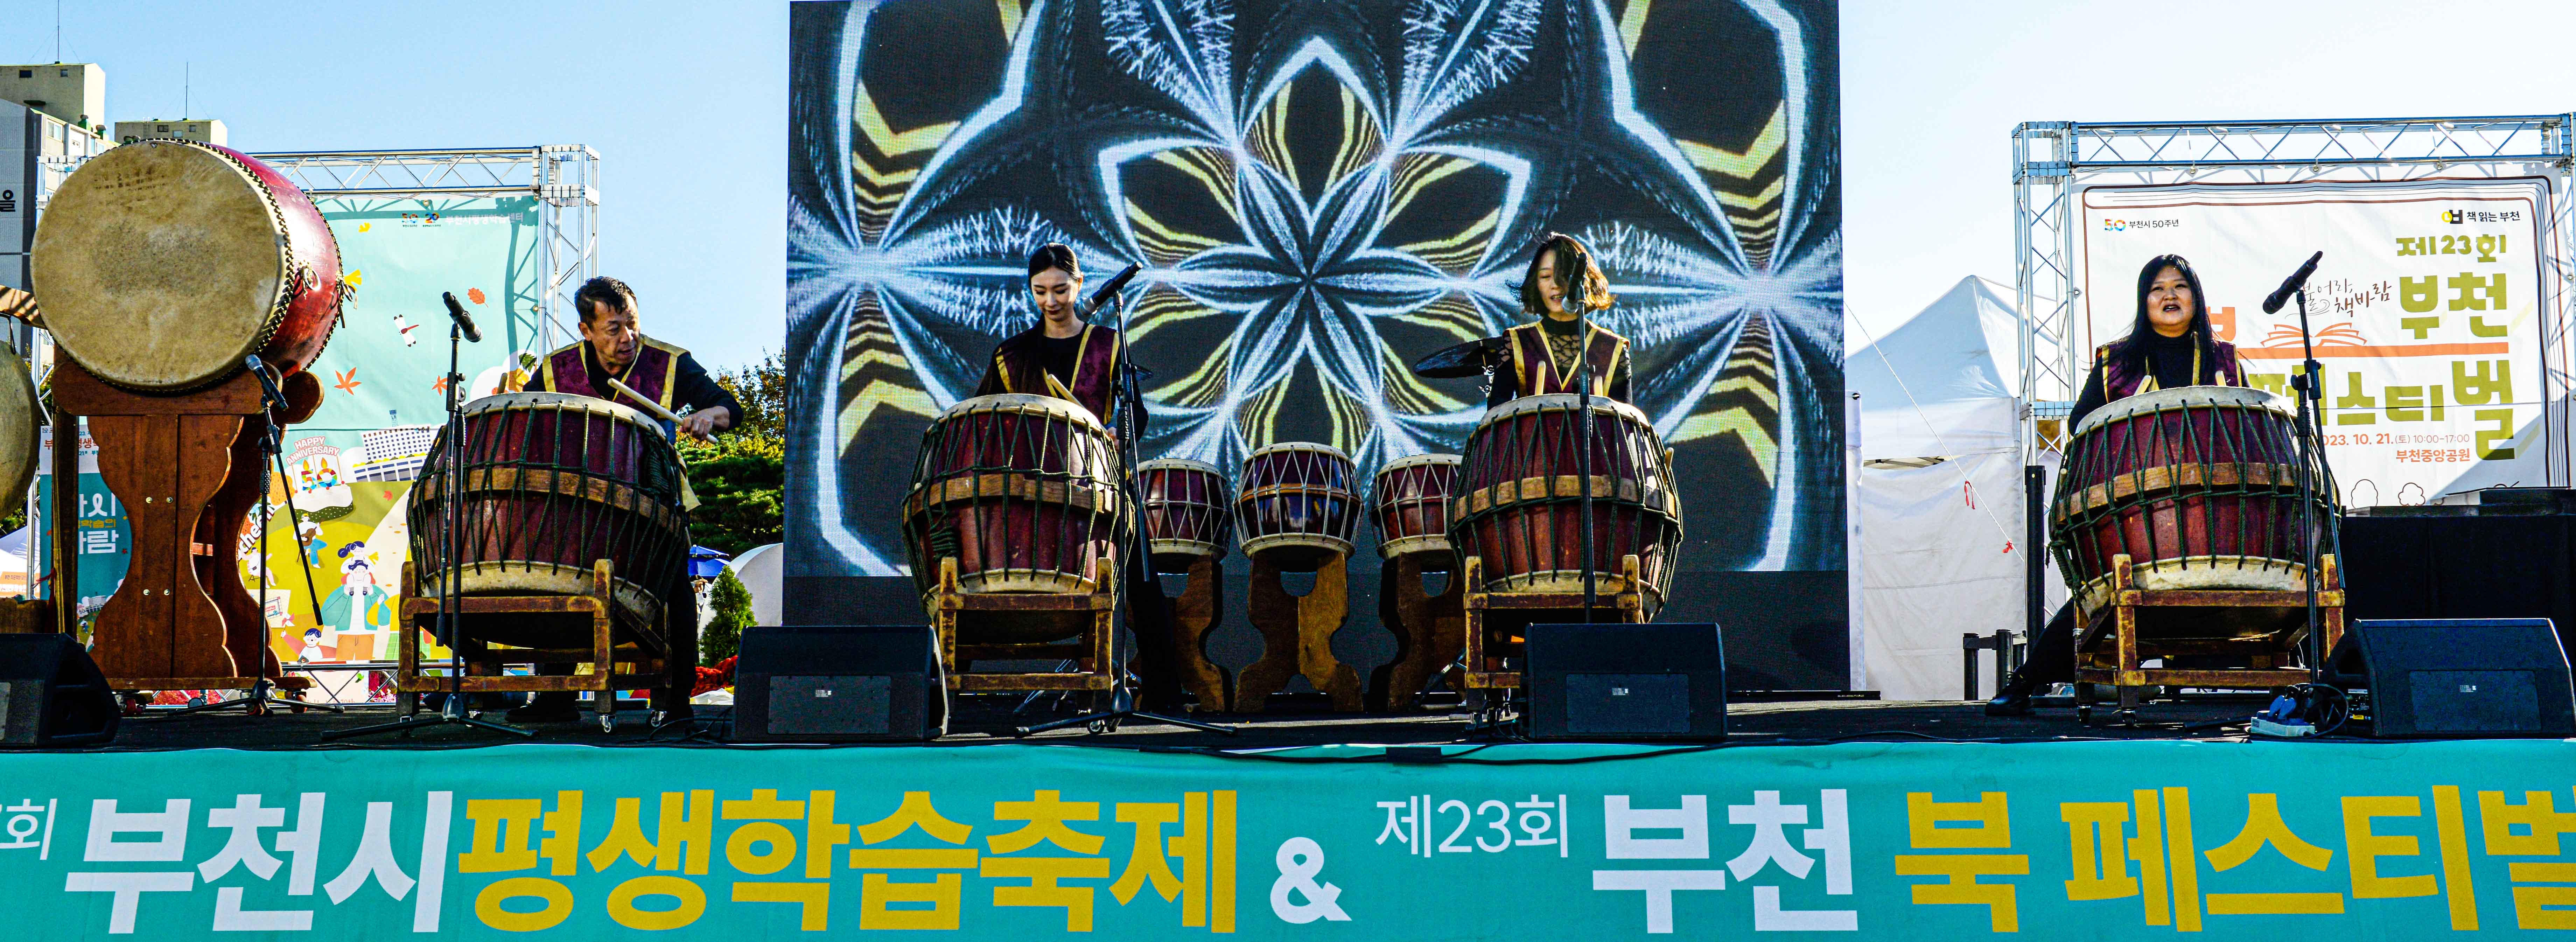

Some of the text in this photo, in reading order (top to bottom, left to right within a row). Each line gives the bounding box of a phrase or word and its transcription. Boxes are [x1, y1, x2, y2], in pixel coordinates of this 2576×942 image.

[2129, 220, 2150, 228] 부천시
[2152, 219, 2179, 228] 50주년
[2467, 211, 2520, 222] 책 읽는 부천
[2396, 234, 2506, 263] 제23회
[2334, 281, 2392, 318] 책바람
[2400, 272, 2508, 340] 부천
[294, 436, 326, 449] HAPPY
[2322, 434, 2349, 446] 023.
[2353, 434, 2372, 445] 10.
[2414, 434, 2470, 443] 10:00-17:00
[286, 445, 341, 465] ANNIVERSARY
[2396, 448, 2470, 462] 부천중앙공원
[0, 798, 57, 860] 회
[1270, 837, 1352, 924] &
[1376, 794, 1568, 858] 제23회
[1592, 789, 1858, 934] 부천
[1895, 791, 2030, 933] 북
[2060, 785, 2576, 932] 페스티벌
